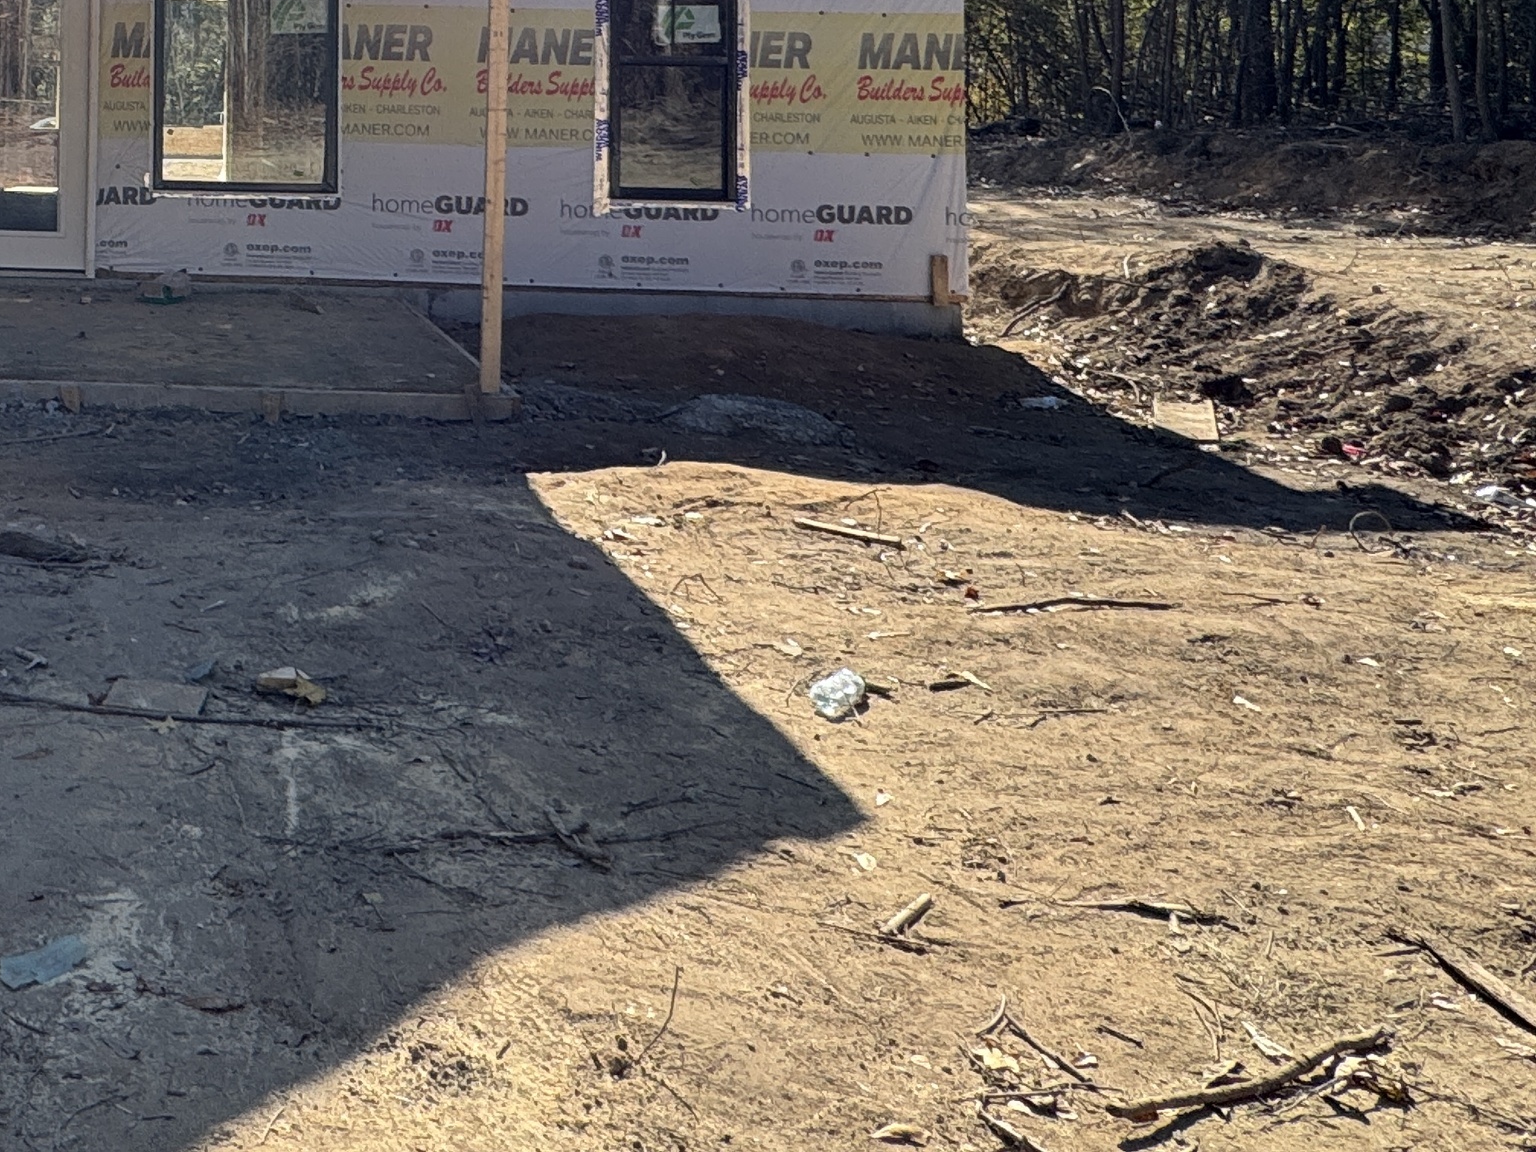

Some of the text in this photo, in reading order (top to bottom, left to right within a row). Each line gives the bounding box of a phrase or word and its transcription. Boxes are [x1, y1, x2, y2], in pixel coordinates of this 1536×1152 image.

[342, 23, 434, 63] NER
[357, 65, 448, 98] Supply Co.
[545, 70, 595, 103] Suppl
[749, 74, 828, 106] upply Co.
[856, 74, 967, 107] Builders Supp
[103, 101, 146, 111] AUGUSTA
[375, 105, 441, 116] CHARLESTON
[524, 109, 555, 119] AIKEN
[753, 112, 822, 124] CHARLESTON
[849, 114, 938, 125] AUGUSTA AIKEN
[860, 133, 963, 149] WWW.MANER
[559, 198, 720, 222] hoeGUARD
[751, 204, 913, 226] homeGUARD
[247, 213, 267, 227] OX
[432, 219, 453, 233] OX
[620, 224, 642, 238] OX
[813, 229, 835, 243] OX
[96, 238, 129, 249] .com
[246, 242, 312, 255] oxep.com
[431, 250, 484, 261] oxep.c
[620, 254, 690, 267] oxep.com
[813, 259, 883, 271] oxep.com
